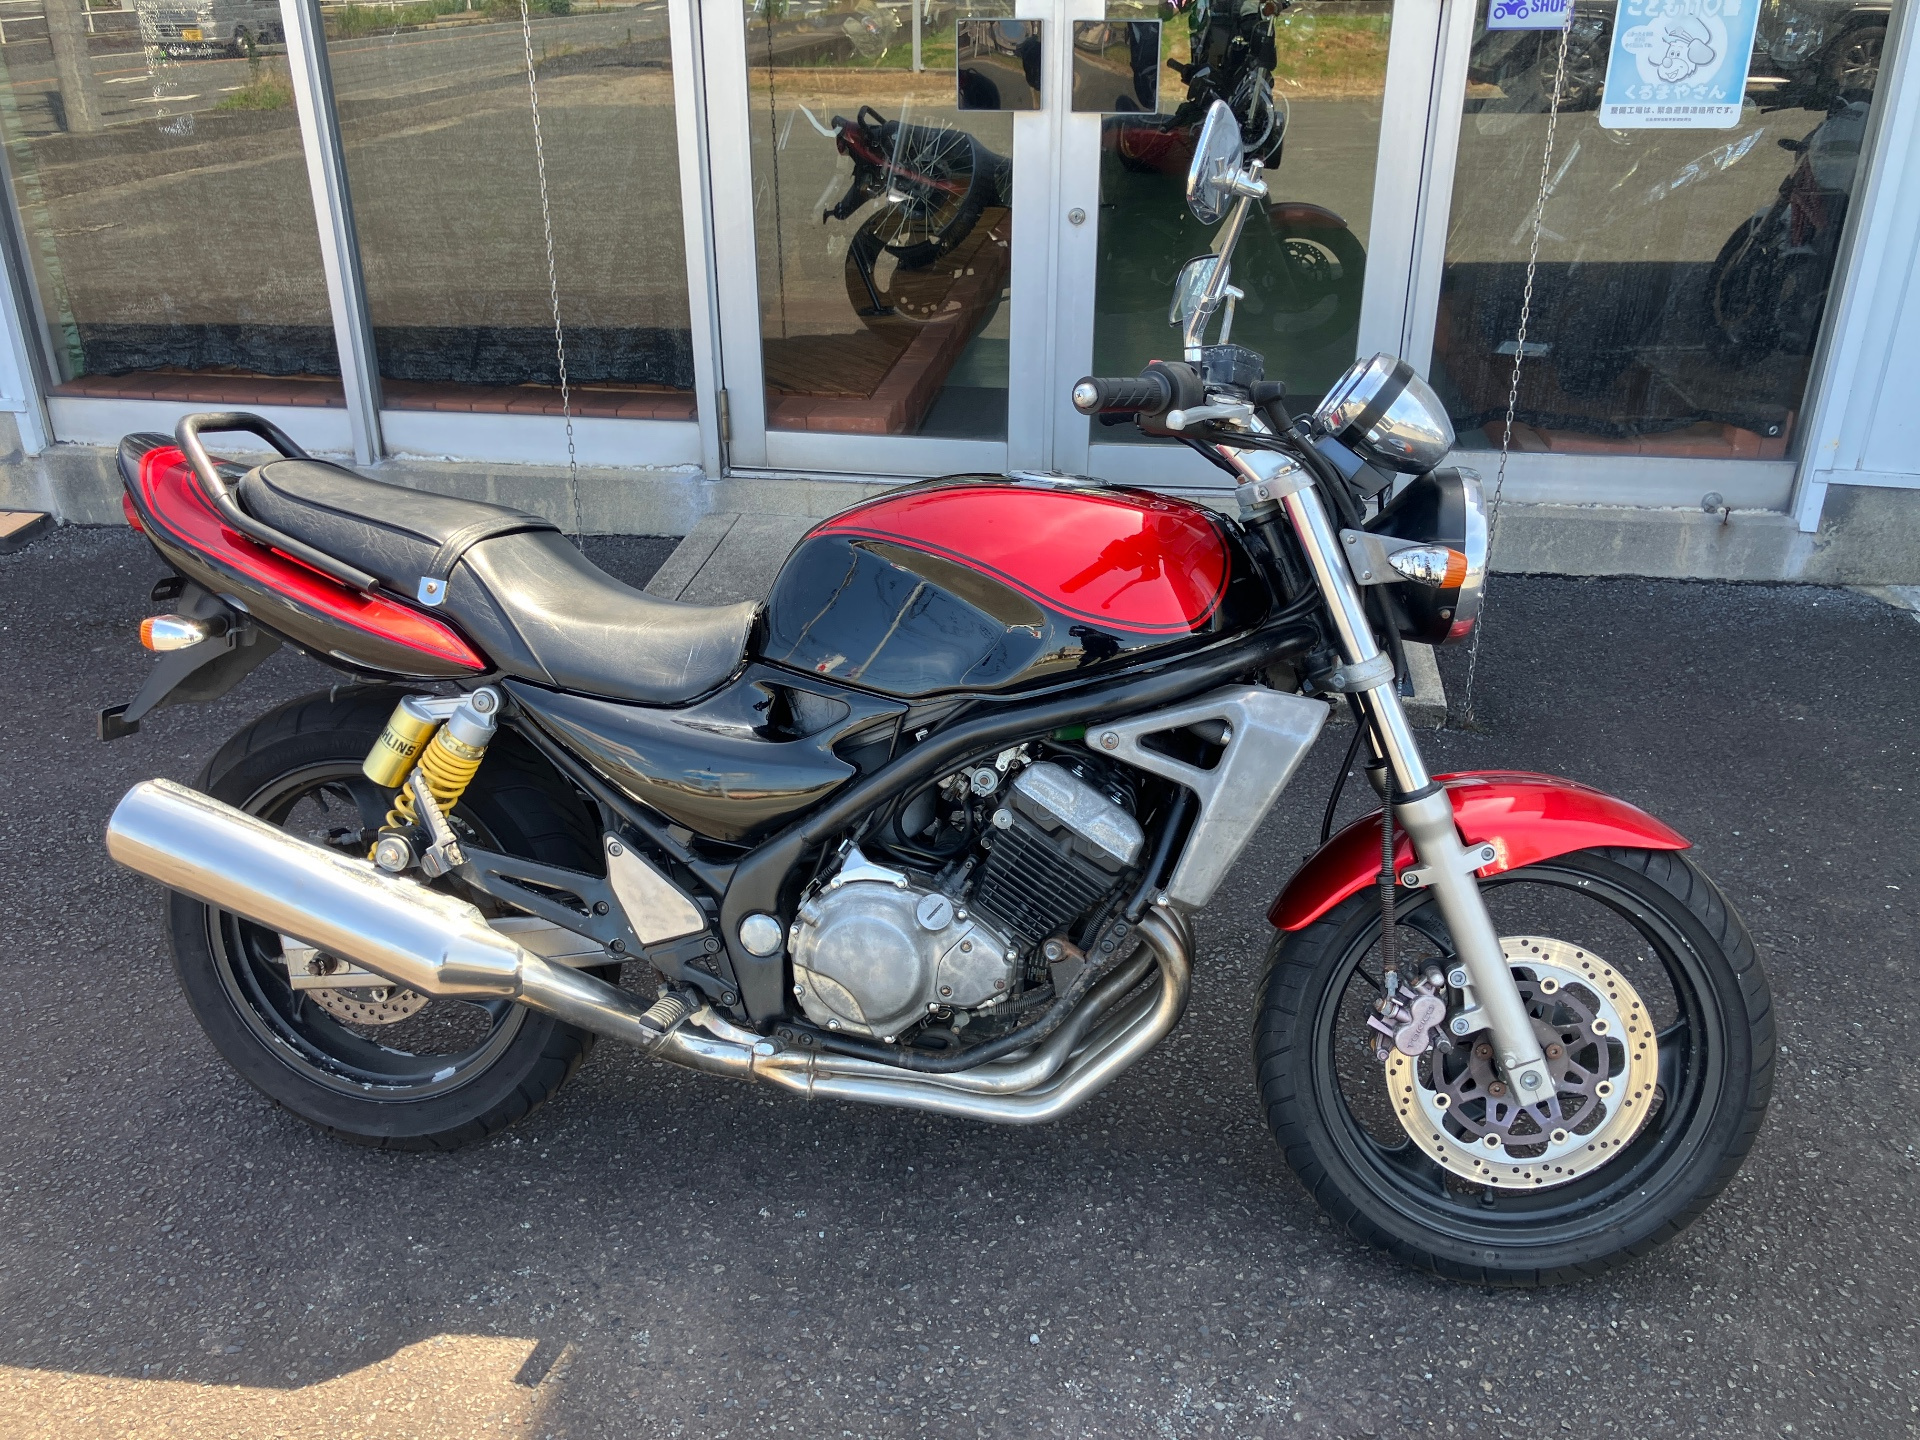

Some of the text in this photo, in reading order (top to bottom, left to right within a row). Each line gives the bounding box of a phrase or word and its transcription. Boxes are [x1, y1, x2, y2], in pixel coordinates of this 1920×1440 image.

[1624, 84, 1727, 100] くるまやさん
[380, 727, 416, 756] HLINS
